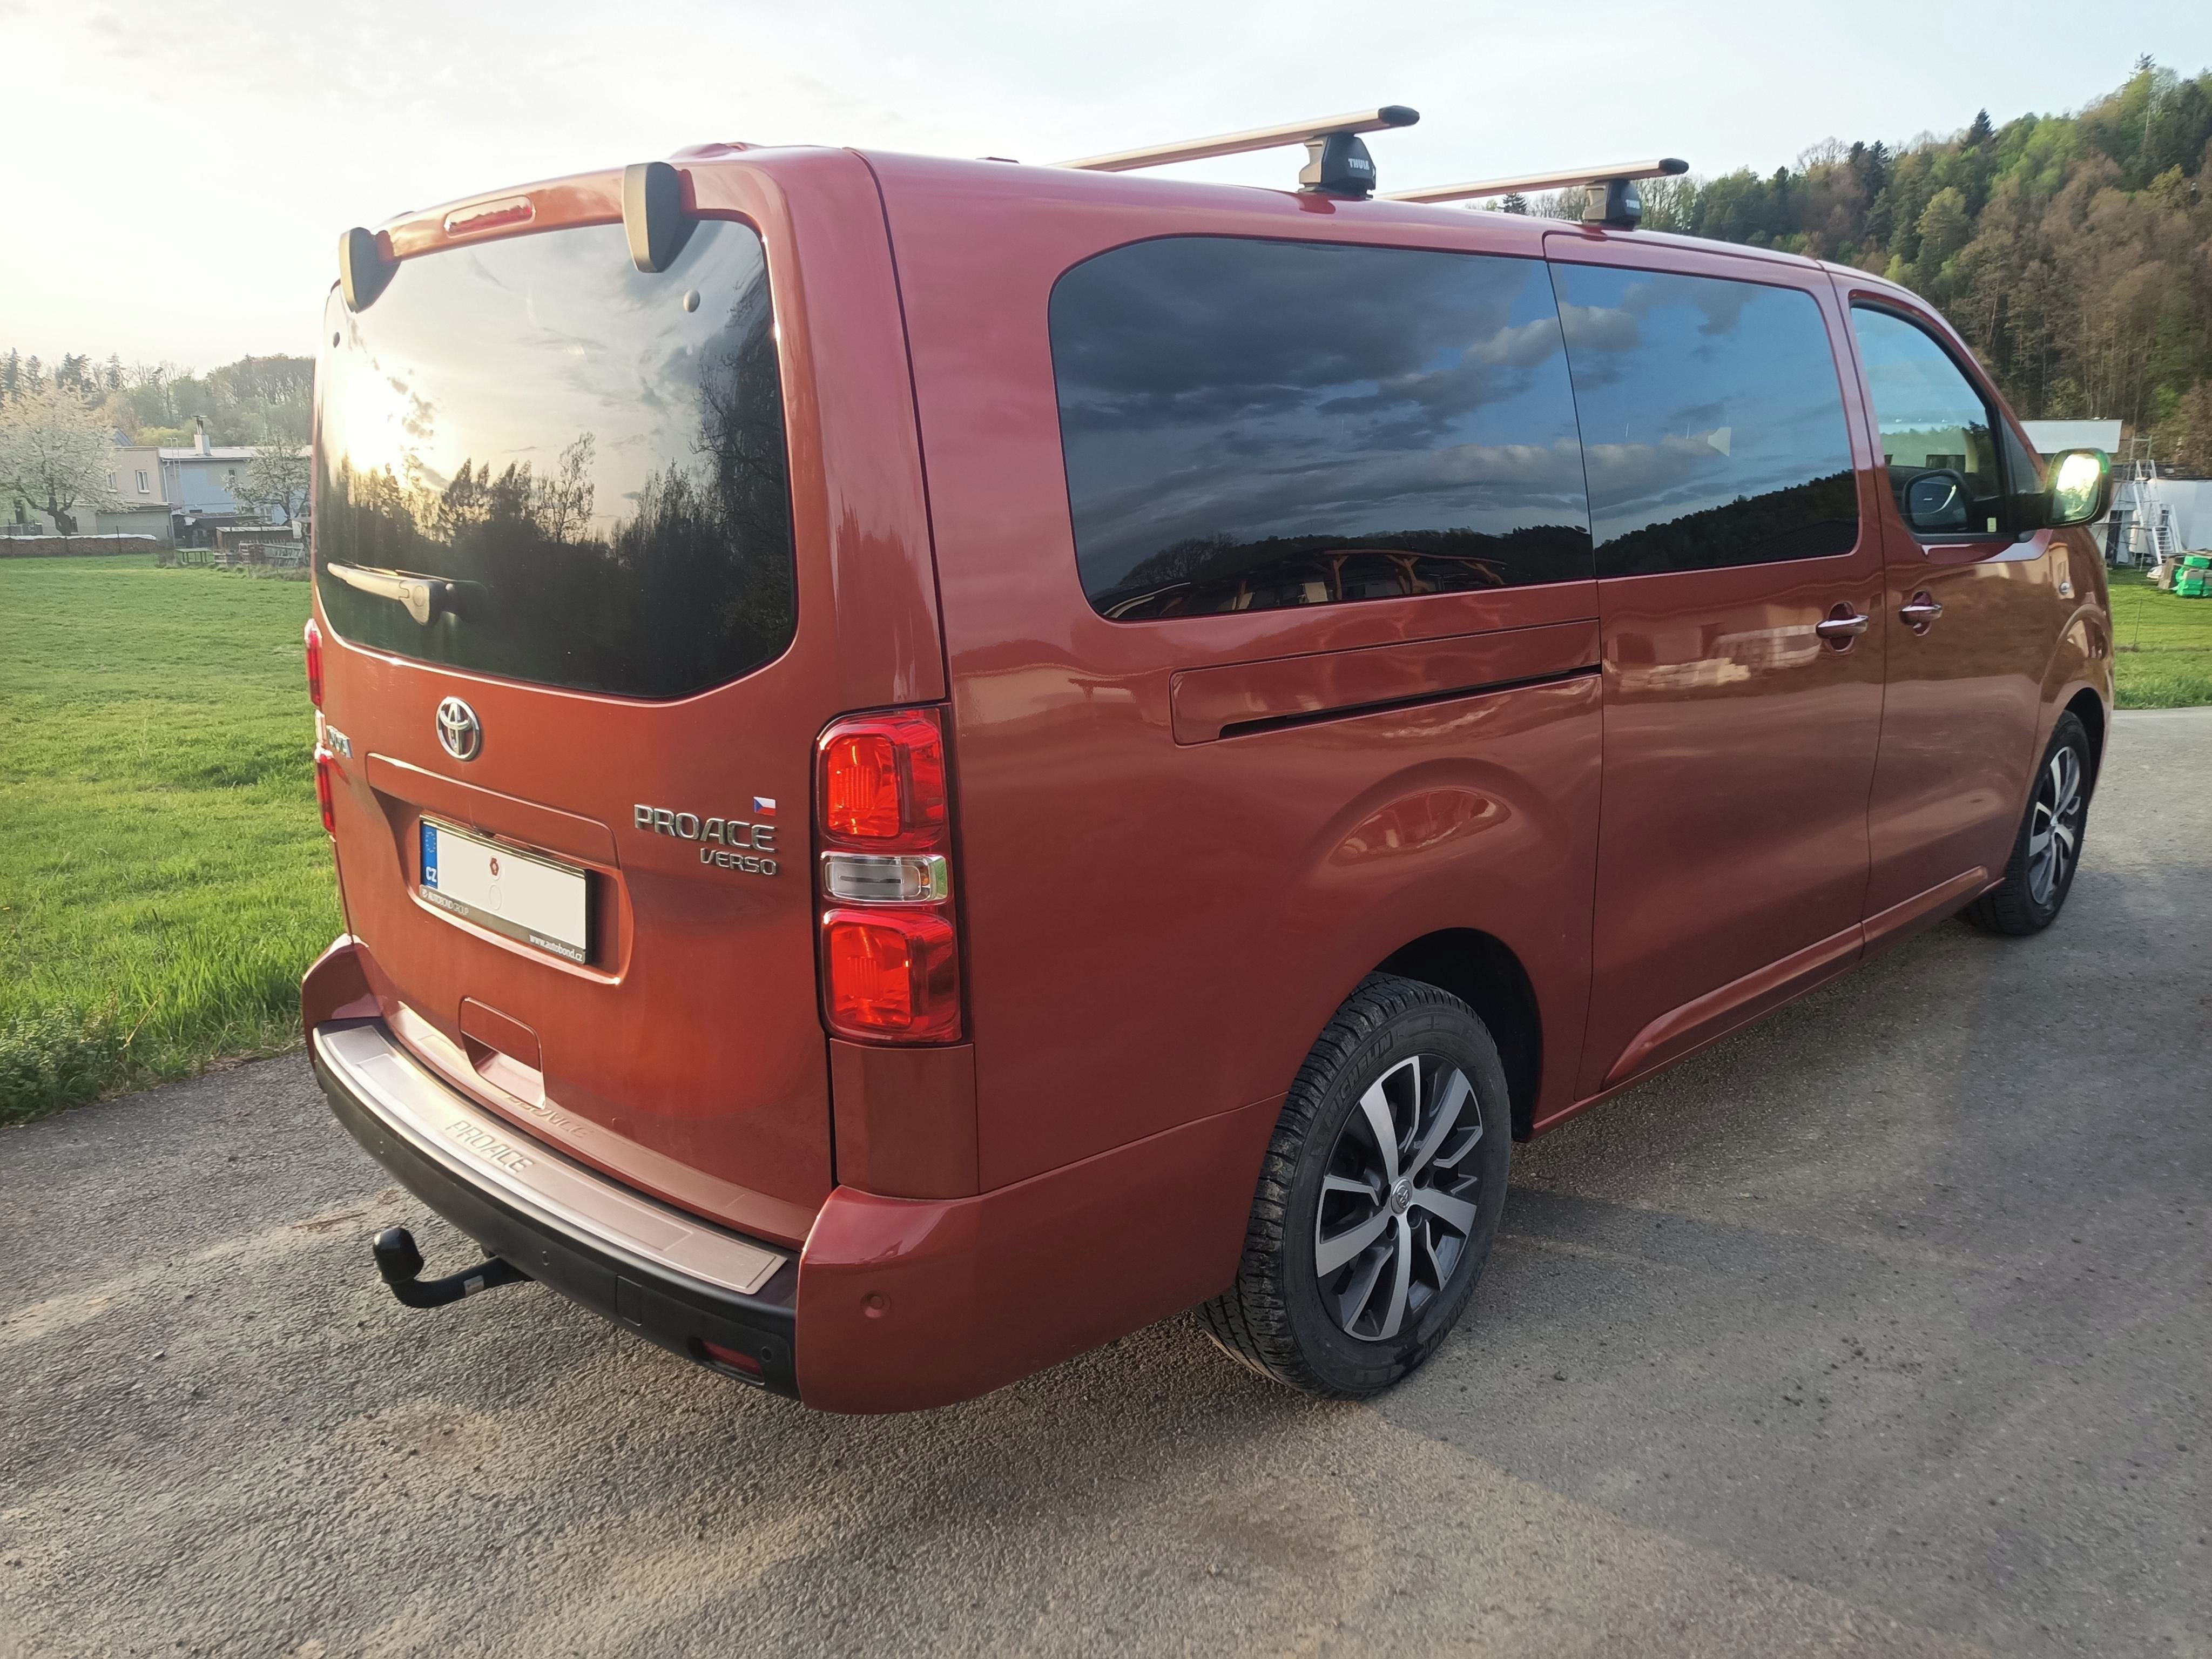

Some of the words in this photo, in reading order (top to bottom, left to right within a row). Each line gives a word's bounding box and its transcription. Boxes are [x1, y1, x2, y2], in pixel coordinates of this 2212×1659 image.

[634, 804, 777, 853] PROACE
[426, 866, 437, 882] CZ
[700, 847, 777, 875] VERSO
[1326, 1031, 1393, 1129] MICHELIN
[446, 1120, 535, 1173] PROACE
